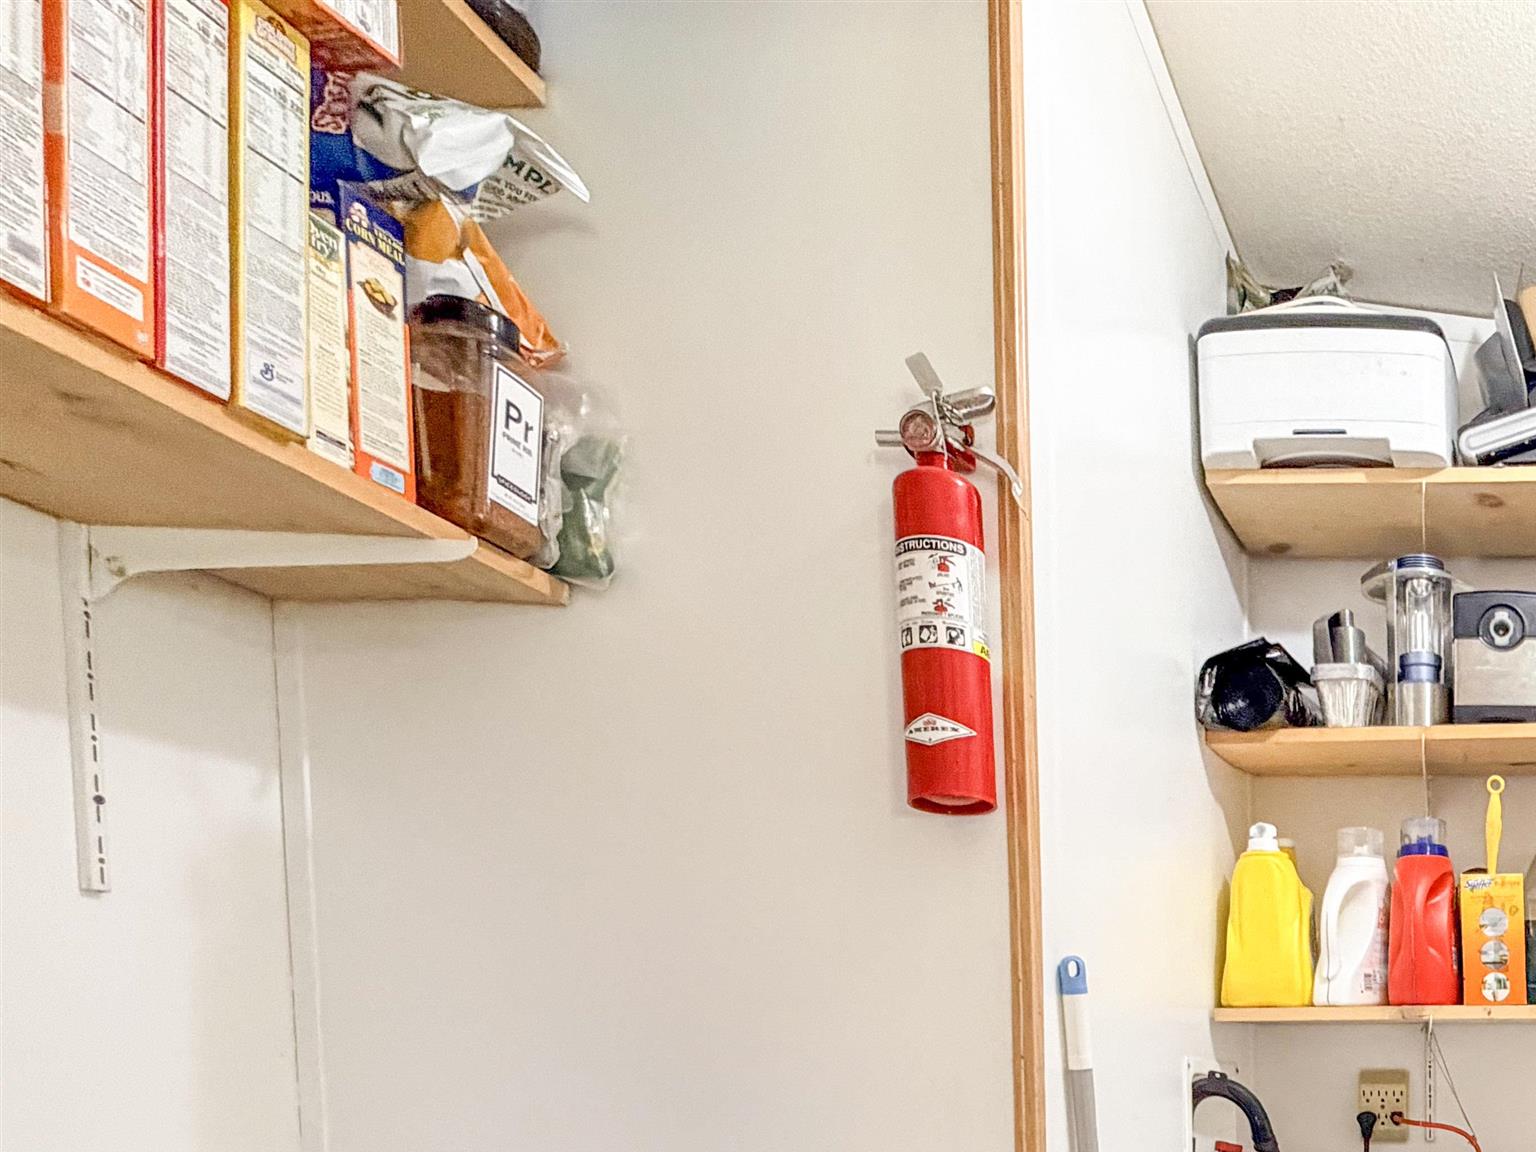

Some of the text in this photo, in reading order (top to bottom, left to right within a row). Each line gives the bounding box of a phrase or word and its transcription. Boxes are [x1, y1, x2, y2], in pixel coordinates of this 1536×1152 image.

[345, 217, 406, 266] CORN MEAL
[504, 398, 534, 444] Pr
